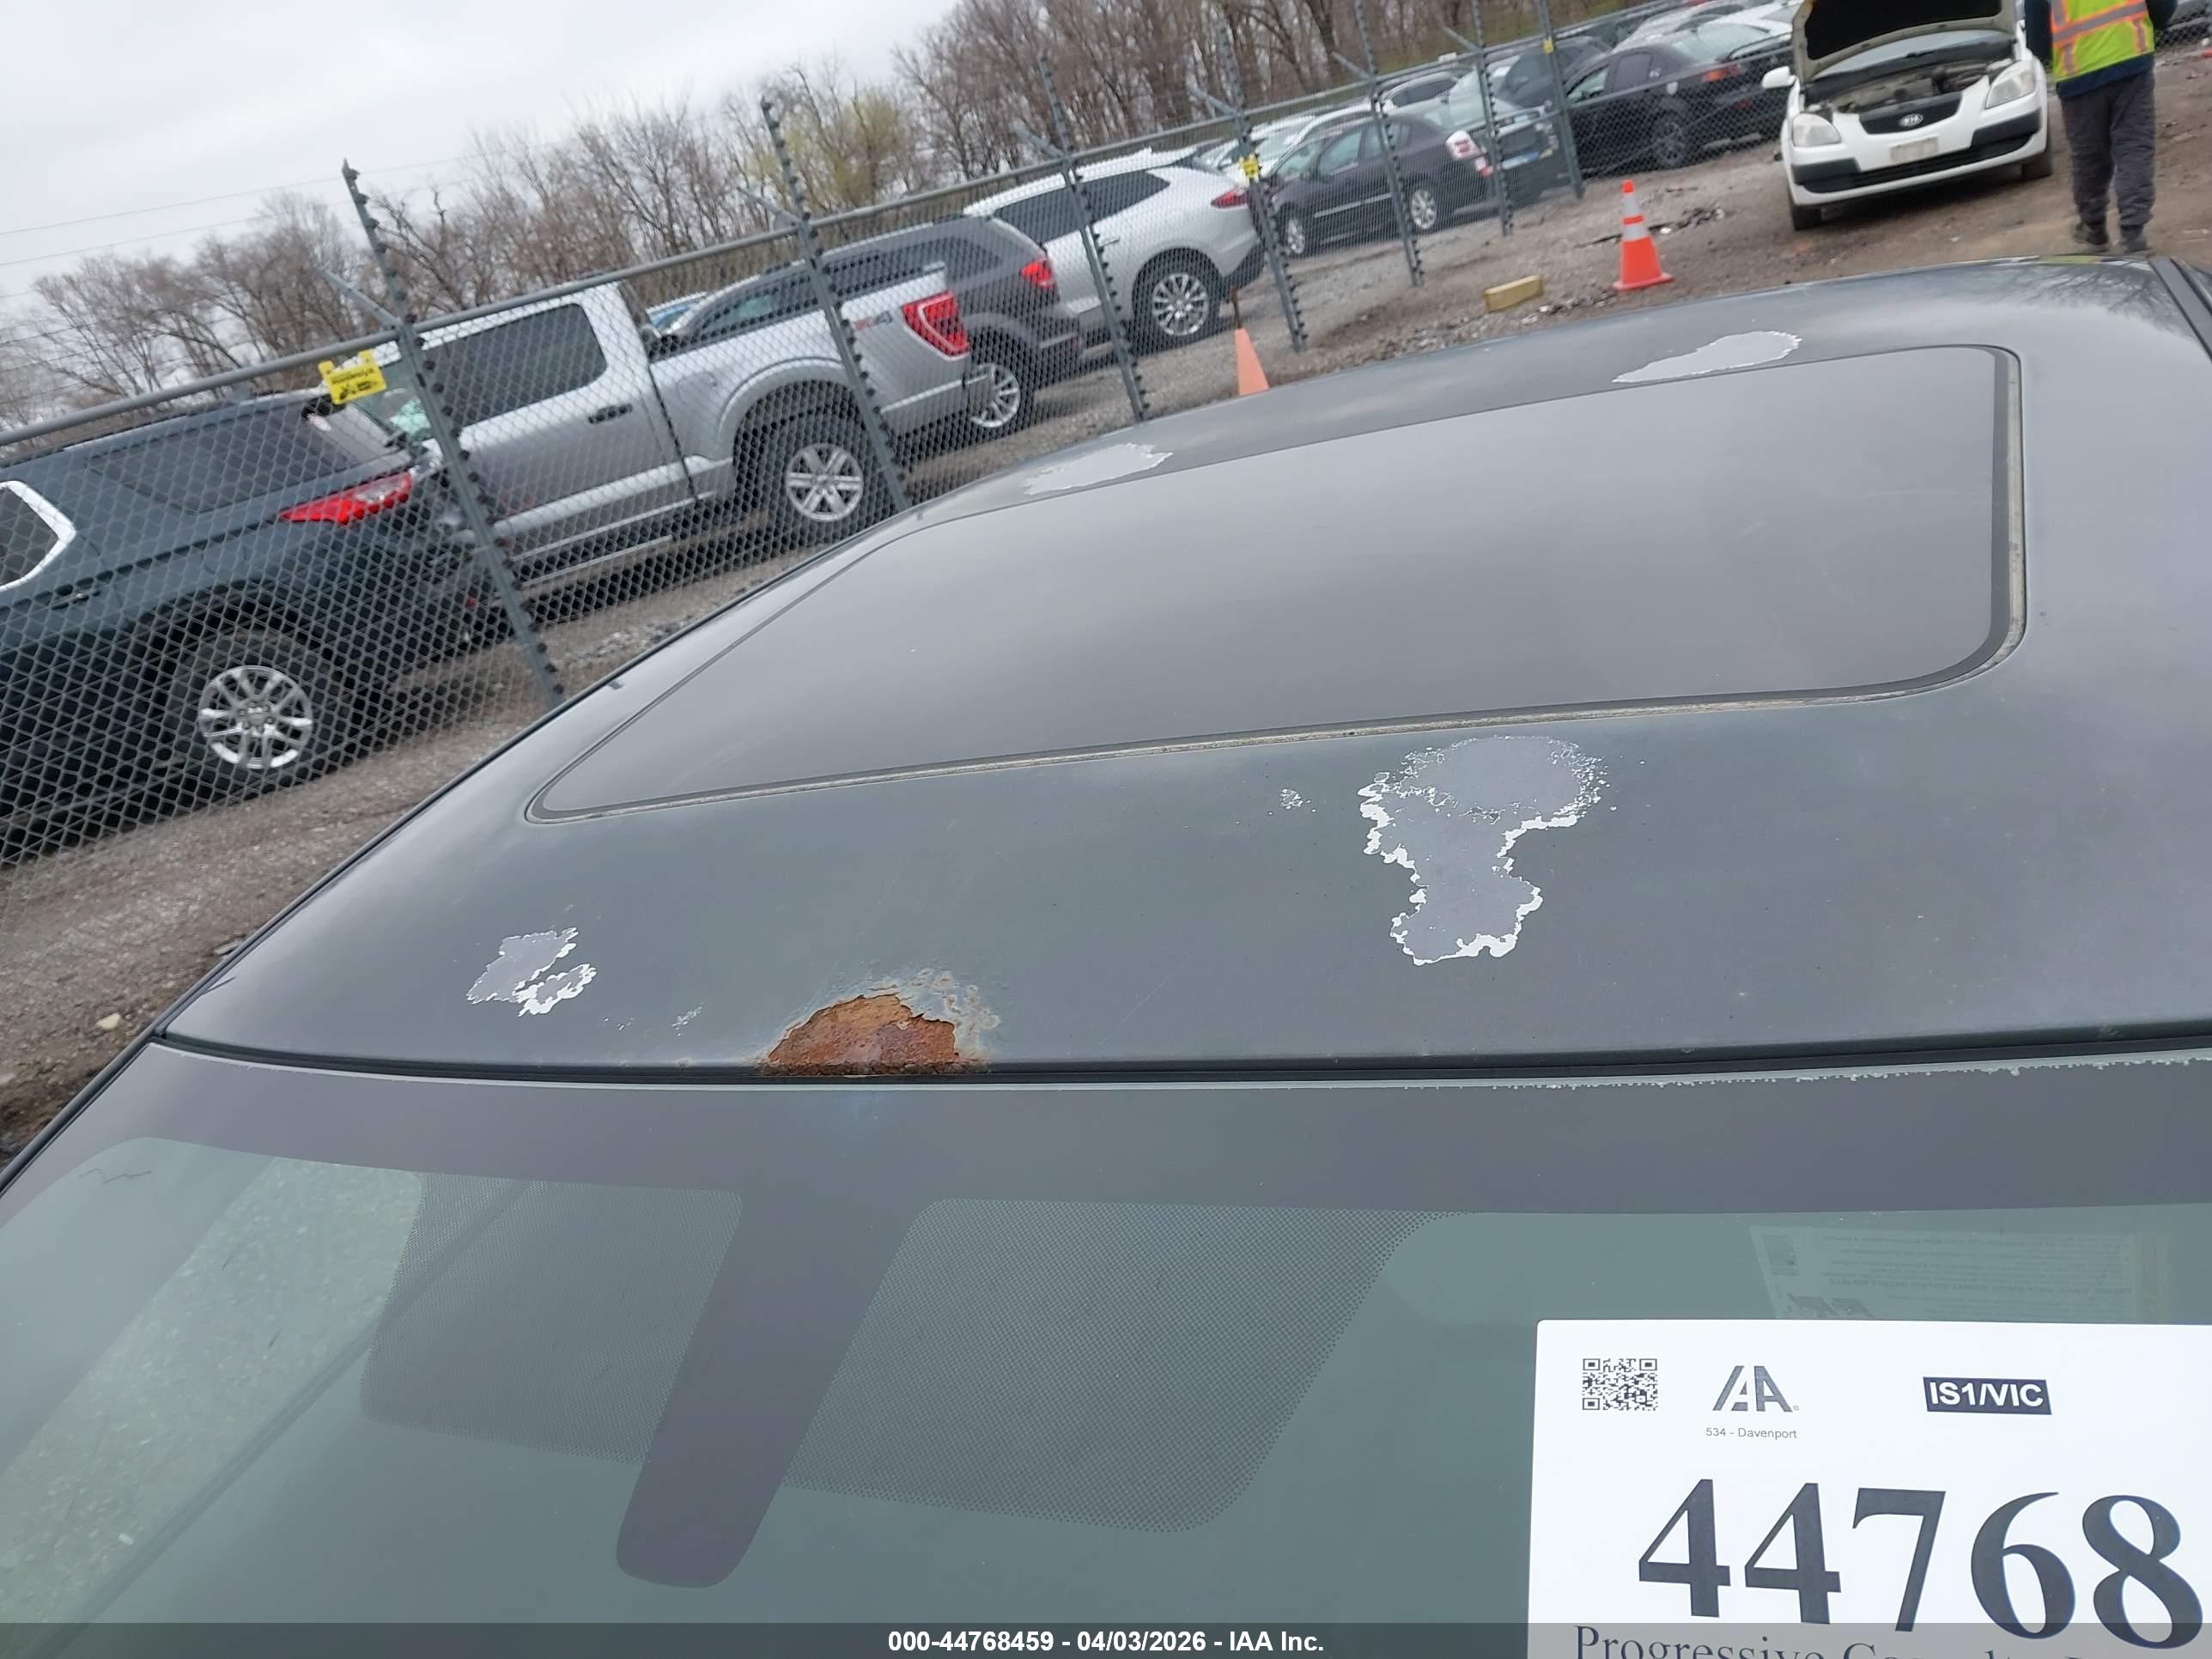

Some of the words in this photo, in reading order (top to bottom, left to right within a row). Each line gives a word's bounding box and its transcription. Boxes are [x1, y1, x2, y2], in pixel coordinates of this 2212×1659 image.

[1929, 1382, 2044, 1407] IS1/VIC
[1705, 1427, 1726, 1437] 534
[1738, 1427, 1797, 1441] Davenport
[1638, 1479, 2203, 1650] 44768
